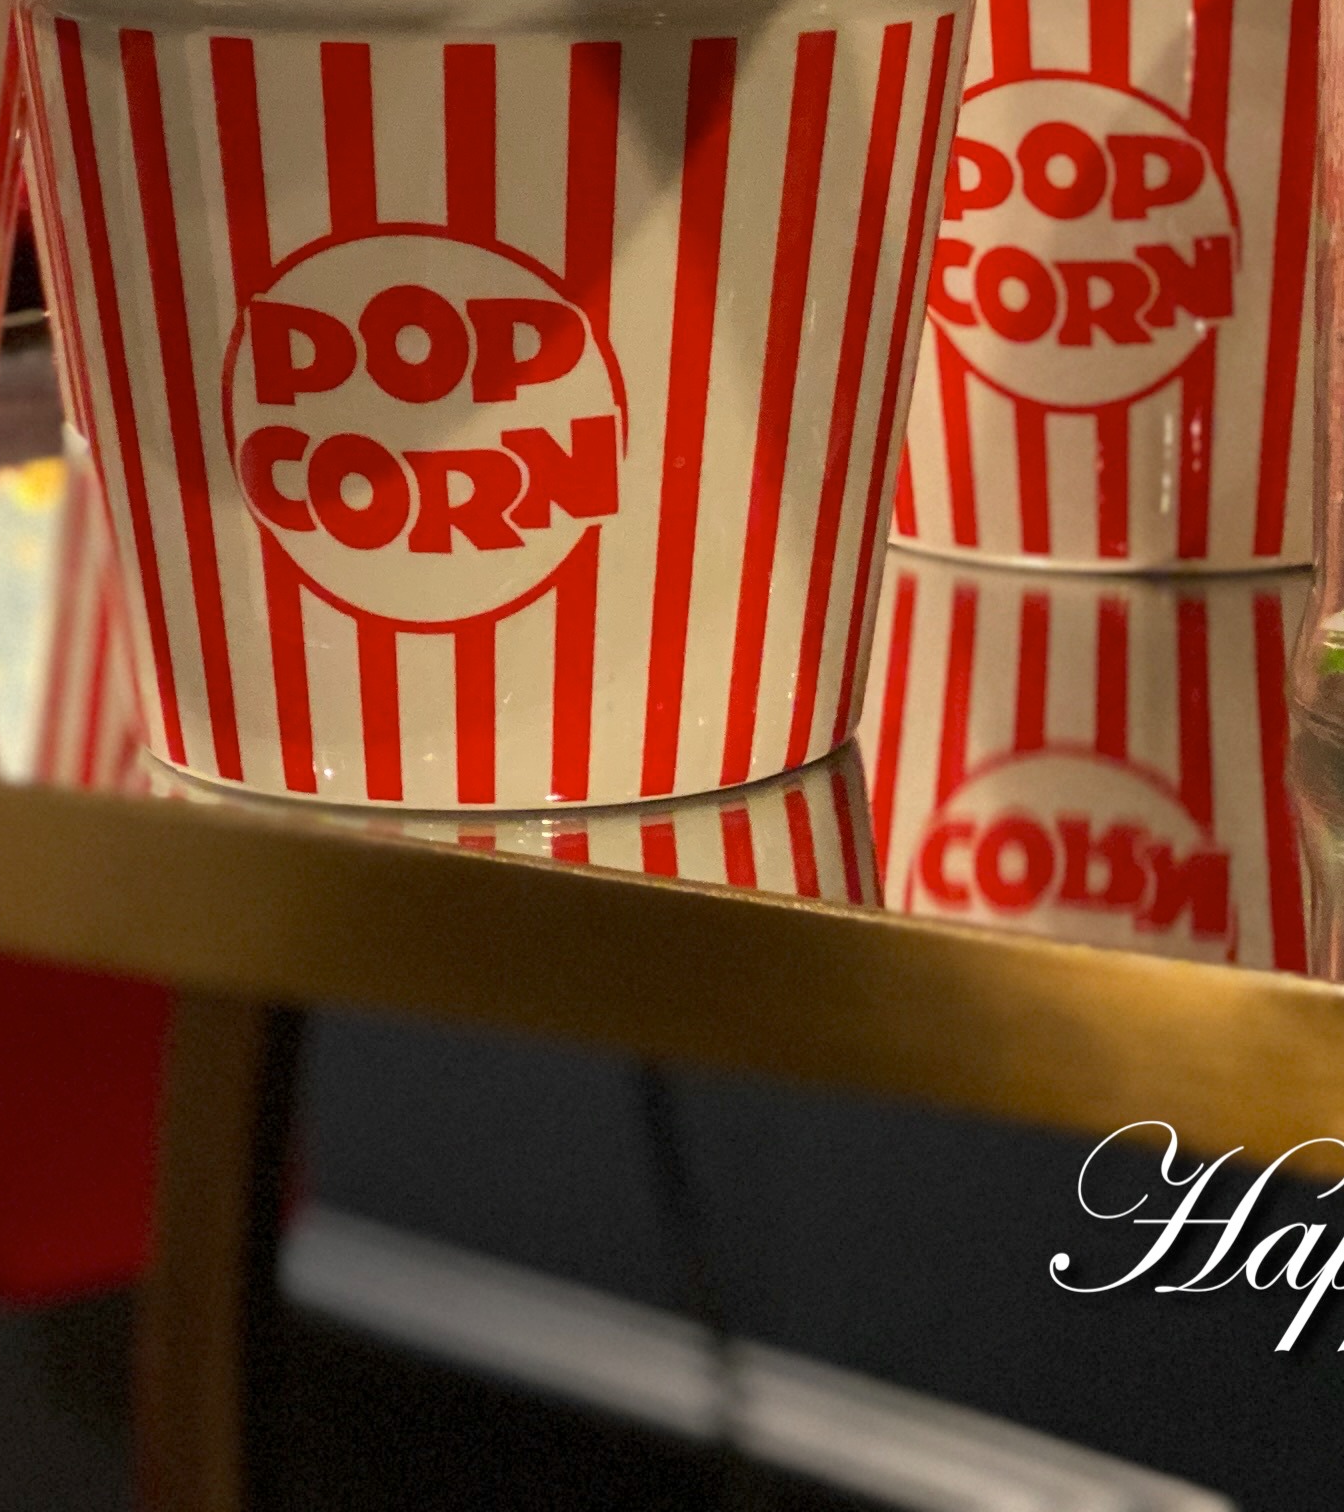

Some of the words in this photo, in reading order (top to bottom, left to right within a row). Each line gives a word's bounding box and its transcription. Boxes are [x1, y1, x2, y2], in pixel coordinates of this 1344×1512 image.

[944, 121, 1205, 221] POP
[251, 284, 585, 406] POP
[928, 235, 1235, 346] CORN
[239, 415, 619, 554] CORN
